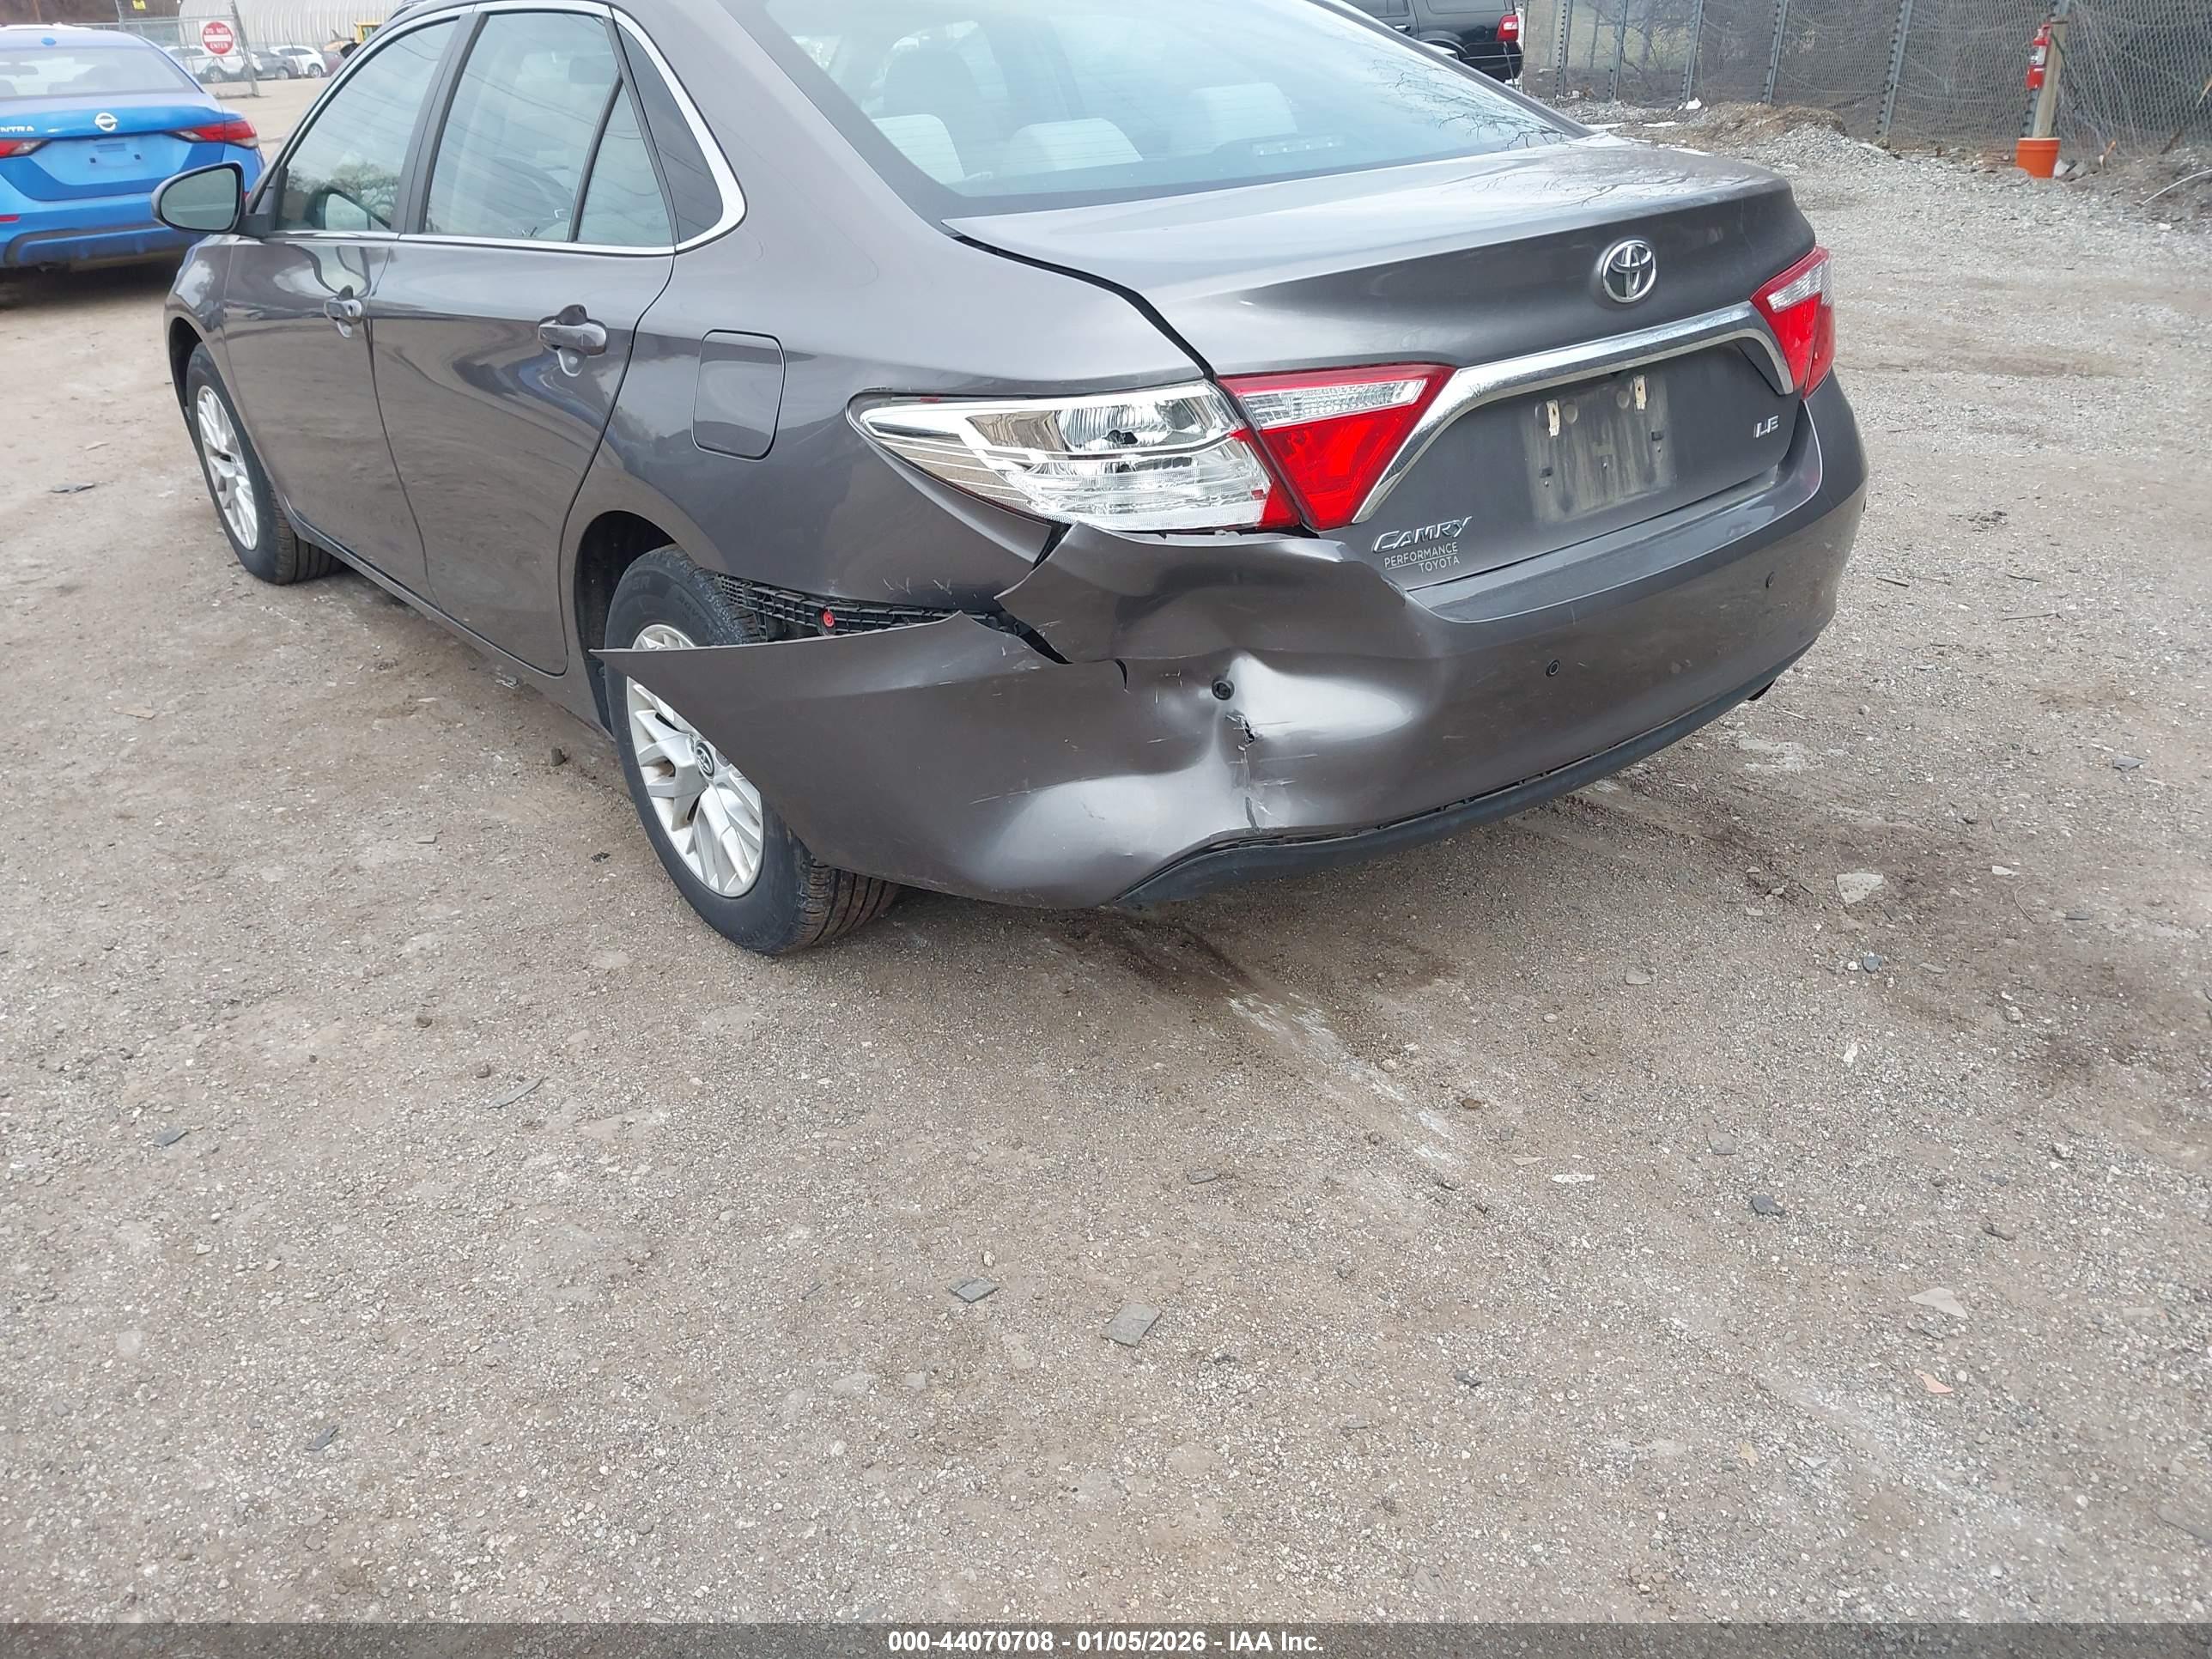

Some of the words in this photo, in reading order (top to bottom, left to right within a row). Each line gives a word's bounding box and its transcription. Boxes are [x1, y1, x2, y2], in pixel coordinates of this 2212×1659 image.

[1753, 415, 1779, 439] LE
[1372, 516, 1473, 552] CAMRY
[1383, 541, 1459, 568] PERFORMANCE
[1419, 555, 1460, 574] TOYOTA
